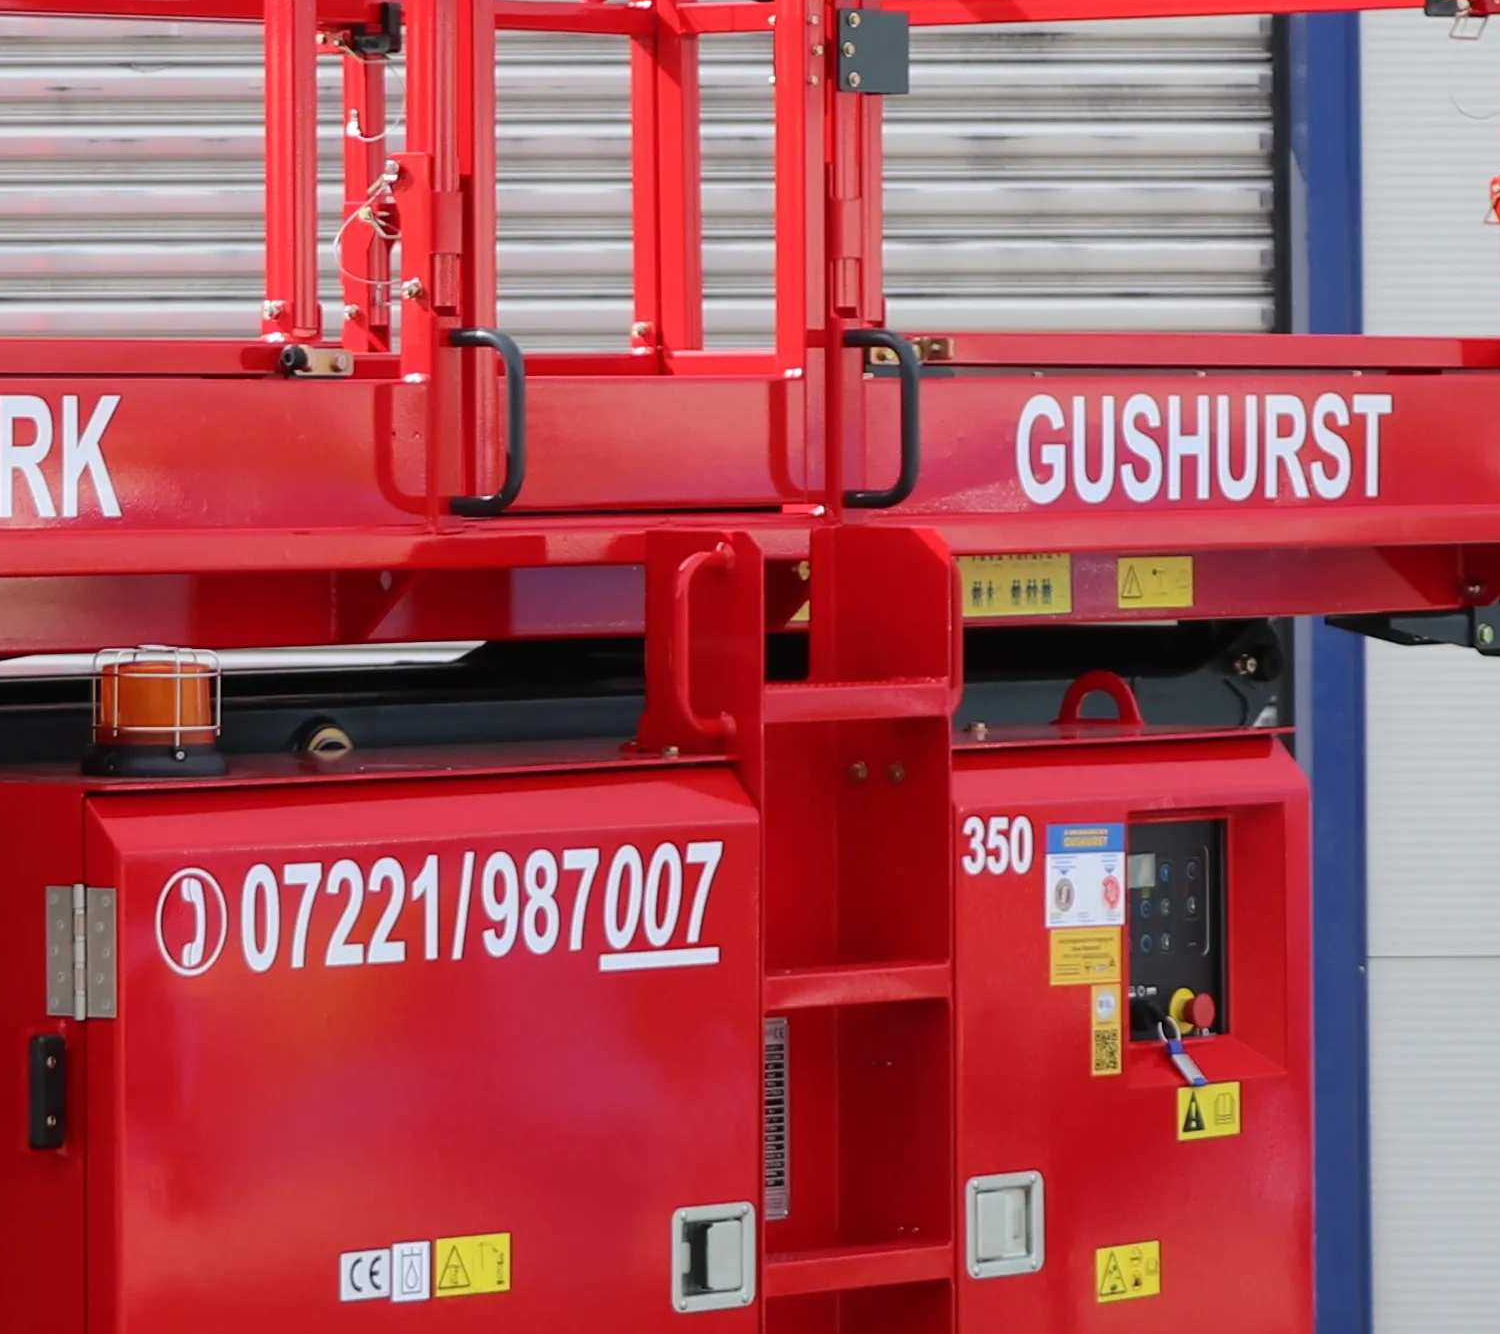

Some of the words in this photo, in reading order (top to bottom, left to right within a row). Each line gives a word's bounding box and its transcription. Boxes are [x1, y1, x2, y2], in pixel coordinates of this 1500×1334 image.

[1016, 392, 1392, 504] GUSHURST
[962, 816, 1033, 876] 350
[242, 841, 723, 972] 07221/987007
